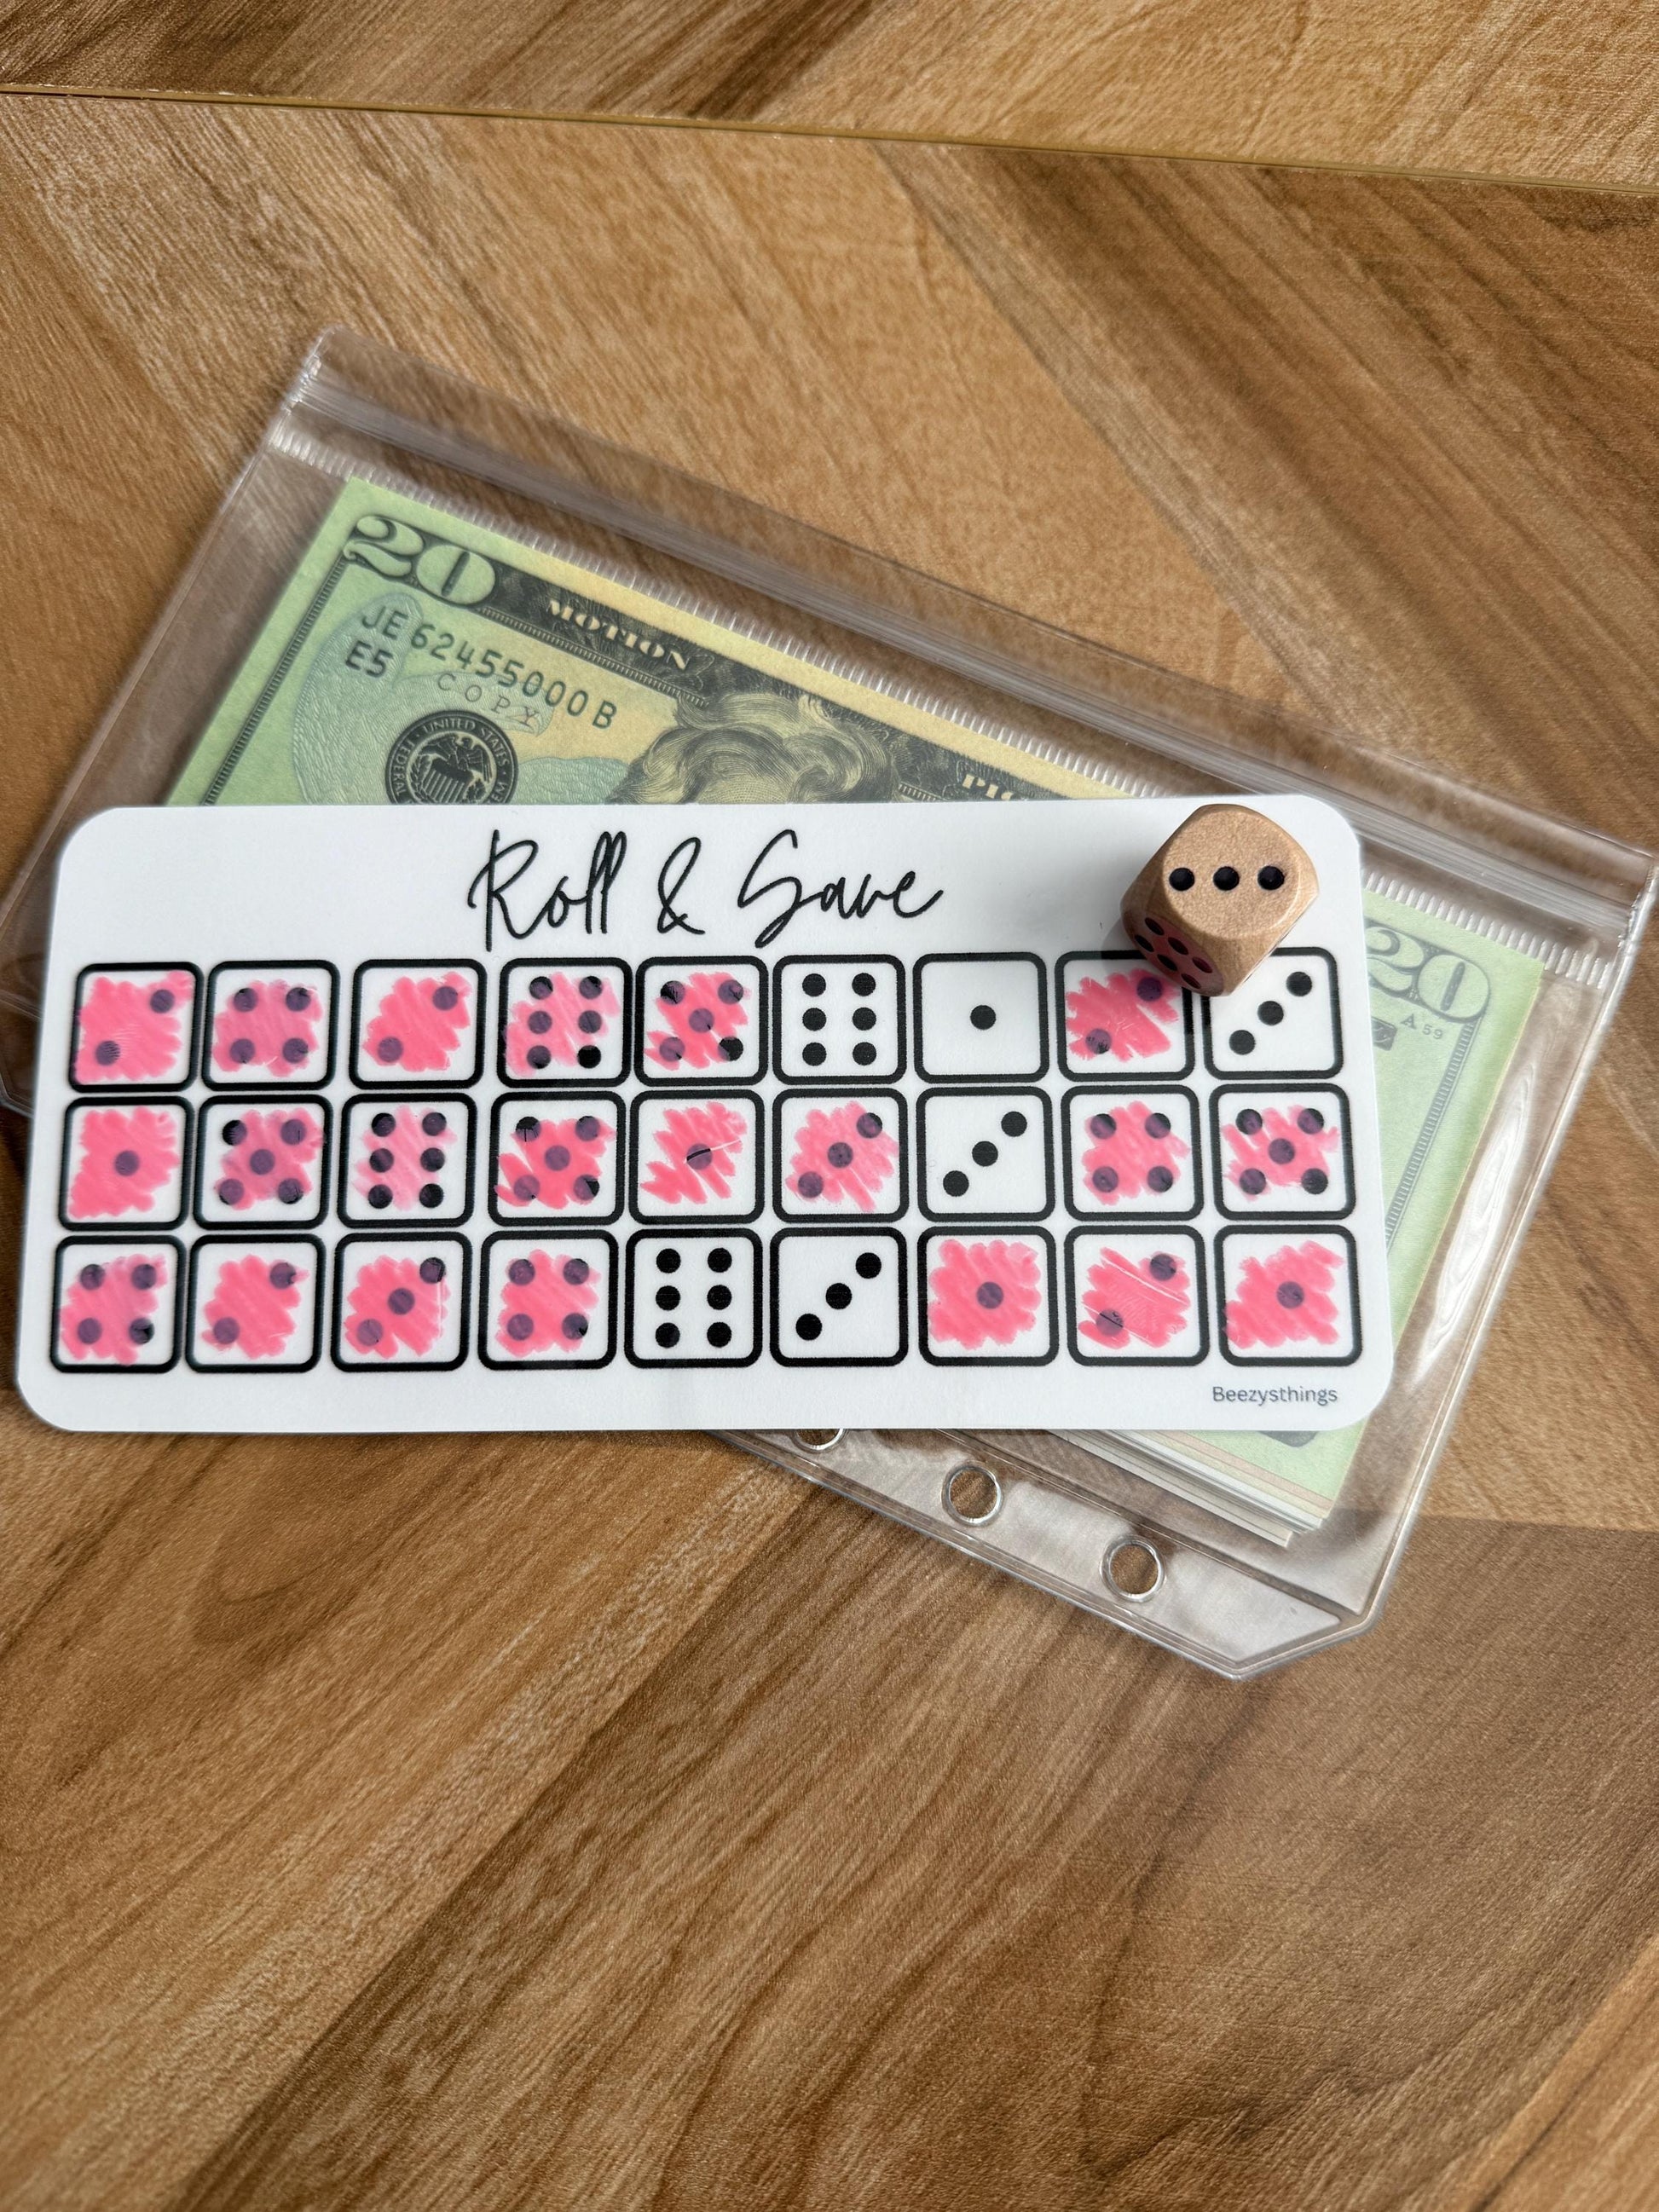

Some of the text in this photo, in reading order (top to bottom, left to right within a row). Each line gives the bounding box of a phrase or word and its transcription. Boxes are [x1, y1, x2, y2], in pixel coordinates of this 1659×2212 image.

[343, 514, 497, 606] 20
[344, 639, 394, 679] E5
[546, 599, 691, 671] MOTION
[361, 605, 618, 730] JE 62455000 B
[436, 673, 540, 728] COPY
[393, 739, 416, 796] FEDERAL
[422, 718, 511, 767] UNITED STATES
[467, 829, 945, 953] Roll & Save
[1212, 1385, 1338, 1406] Beezysthings
